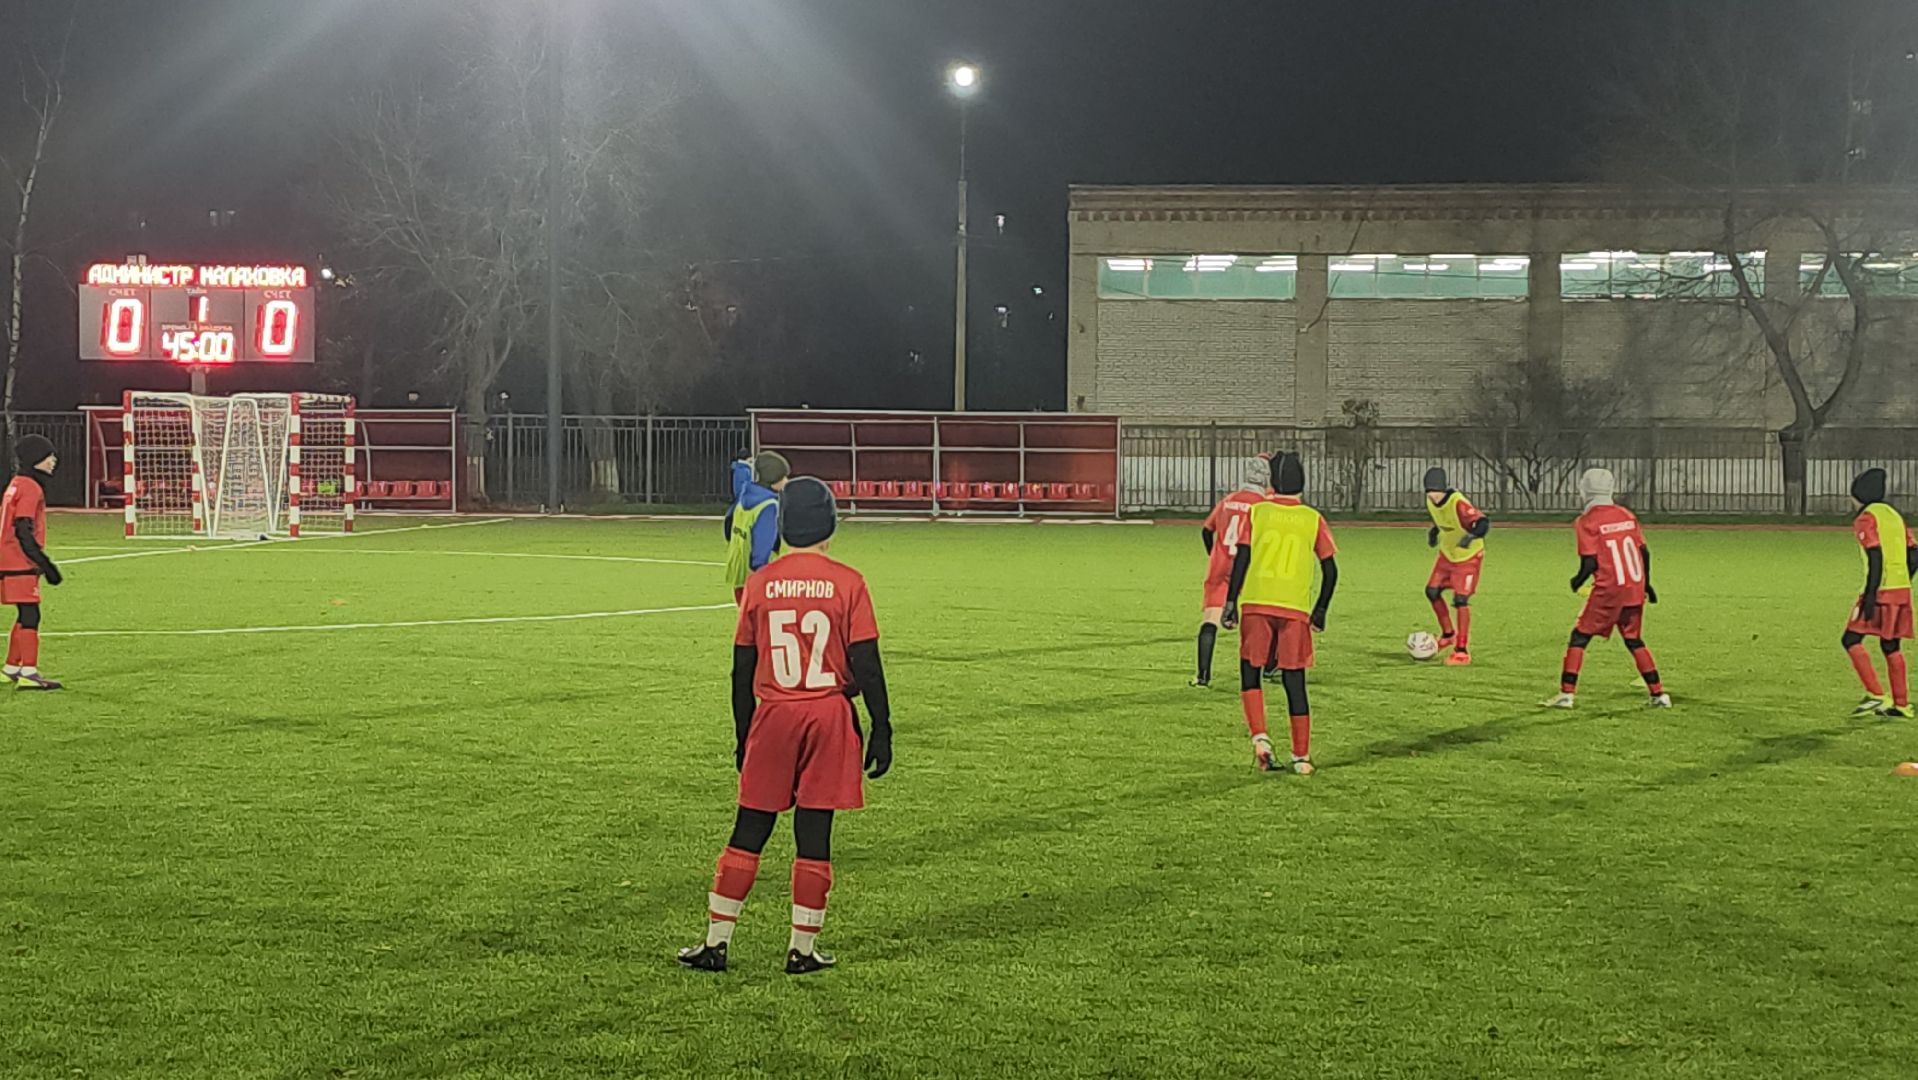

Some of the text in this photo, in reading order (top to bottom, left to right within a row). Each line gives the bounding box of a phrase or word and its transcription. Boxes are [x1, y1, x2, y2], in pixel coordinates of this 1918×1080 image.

[107, 298, 143, 352] 0
[161, 331, 234, 362] 45:00
[261, 300, 297, 353] 0
[1223, 515, 1240, 556] 4
[1256, 529, 1299, 580] 20
[1605, 535, 1642, 586] 10
[765, 579, 835, 599] СМИРНОВ
[768, 609, 838, 689] 52
